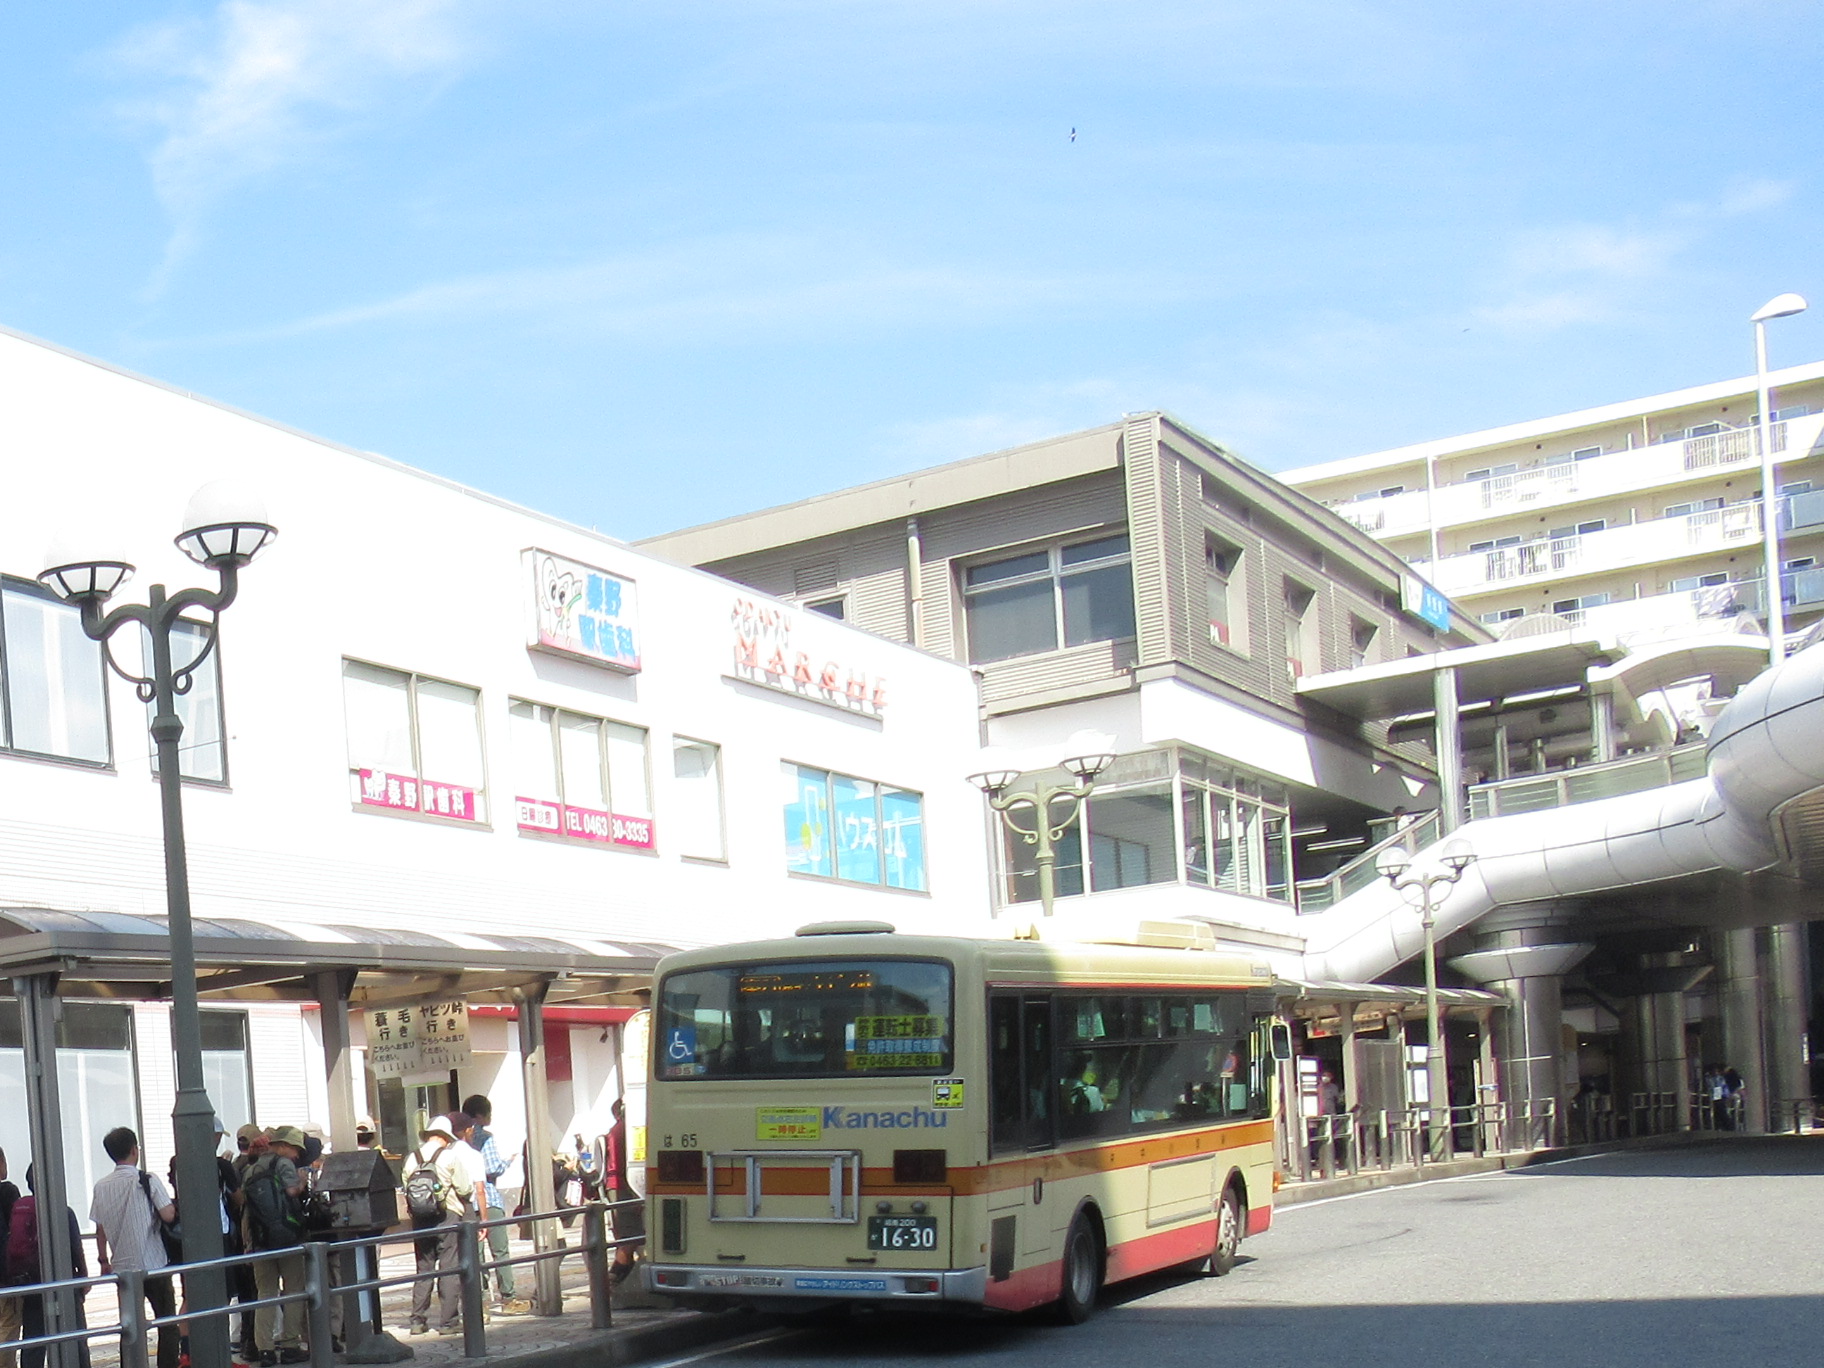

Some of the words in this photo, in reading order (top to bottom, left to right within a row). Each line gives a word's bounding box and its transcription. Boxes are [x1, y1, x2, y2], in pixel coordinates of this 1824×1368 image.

[587, 573, 622, 618] 秦野
[565, 811, 583, 831] TEL
[583, 813, 609, 837] 0463
[374, 1008, 411, 1027] 蓑毛
[419, 1001, 463, 1018] ヤビツ峠
[379, 1025, 408, 1041] 行き
[426, 1018, 456, 1034] 行き
[373, 1041, 415, 1053] こちらへお並び
[421, 1034, 465, 1046] こちらへお並び
[823, 1106, 947, 1129] Kanachu
[681, 1133, 697, 1148] 65
[882, 1228, 934, 1247] 16-30
